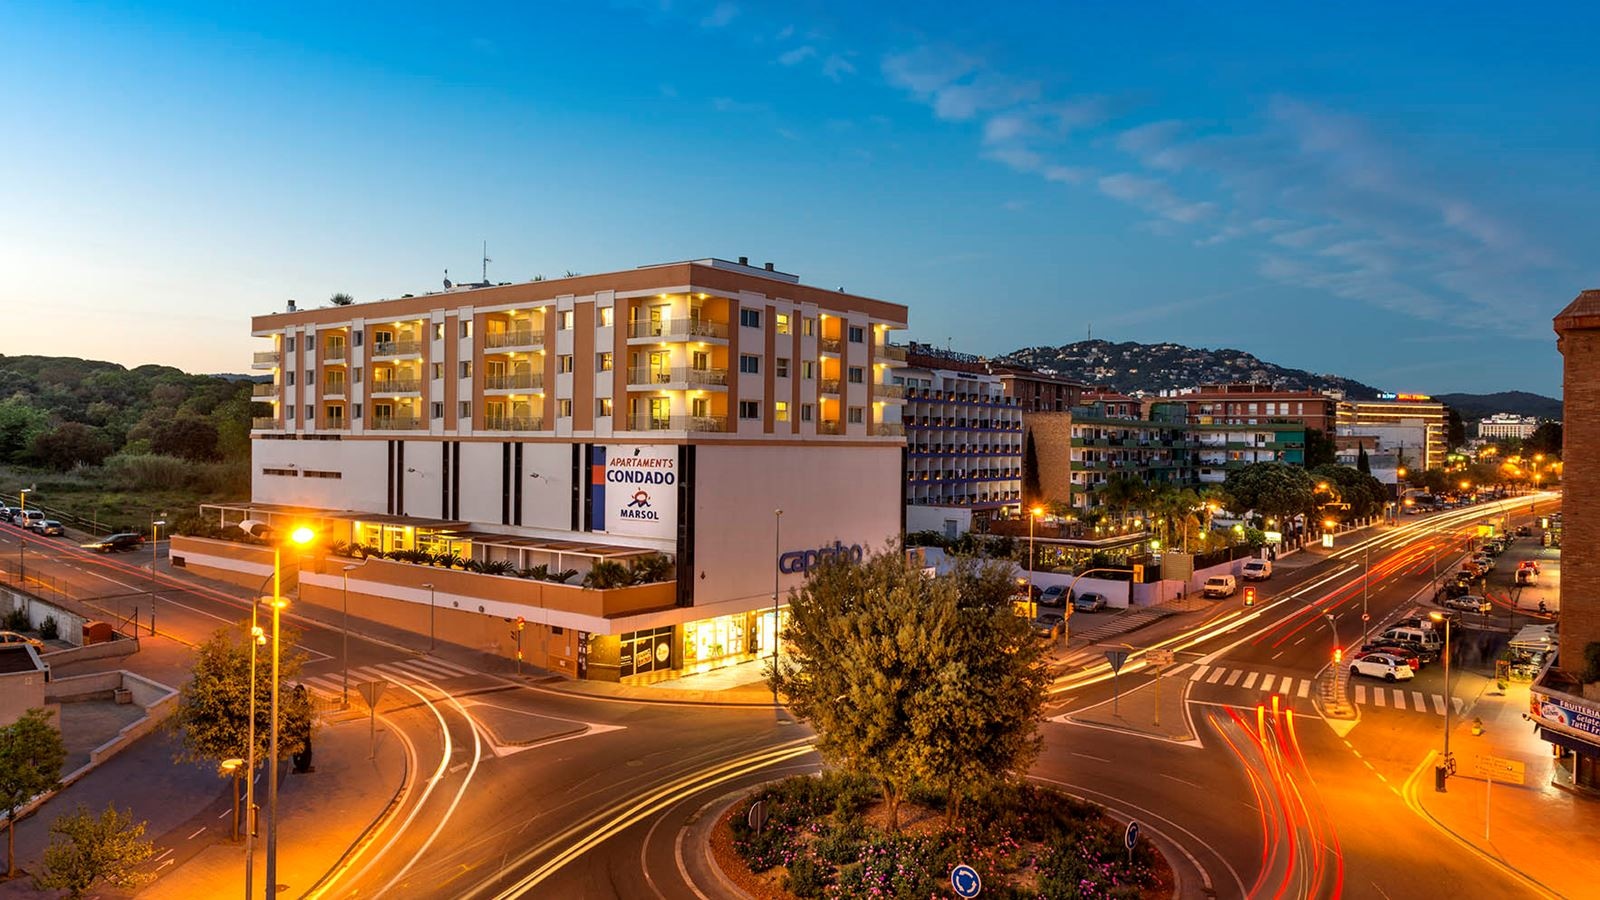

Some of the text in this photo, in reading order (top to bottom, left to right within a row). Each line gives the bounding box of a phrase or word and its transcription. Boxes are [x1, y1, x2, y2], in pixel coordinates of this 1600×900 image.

[610, 458, 673, 468] APARTAMENTS
[606, 469, 675, 485] CONDADO
[620, 509, 659, 520] MARSOL
[1560, 700, 1600, 717] FRUITERIA
